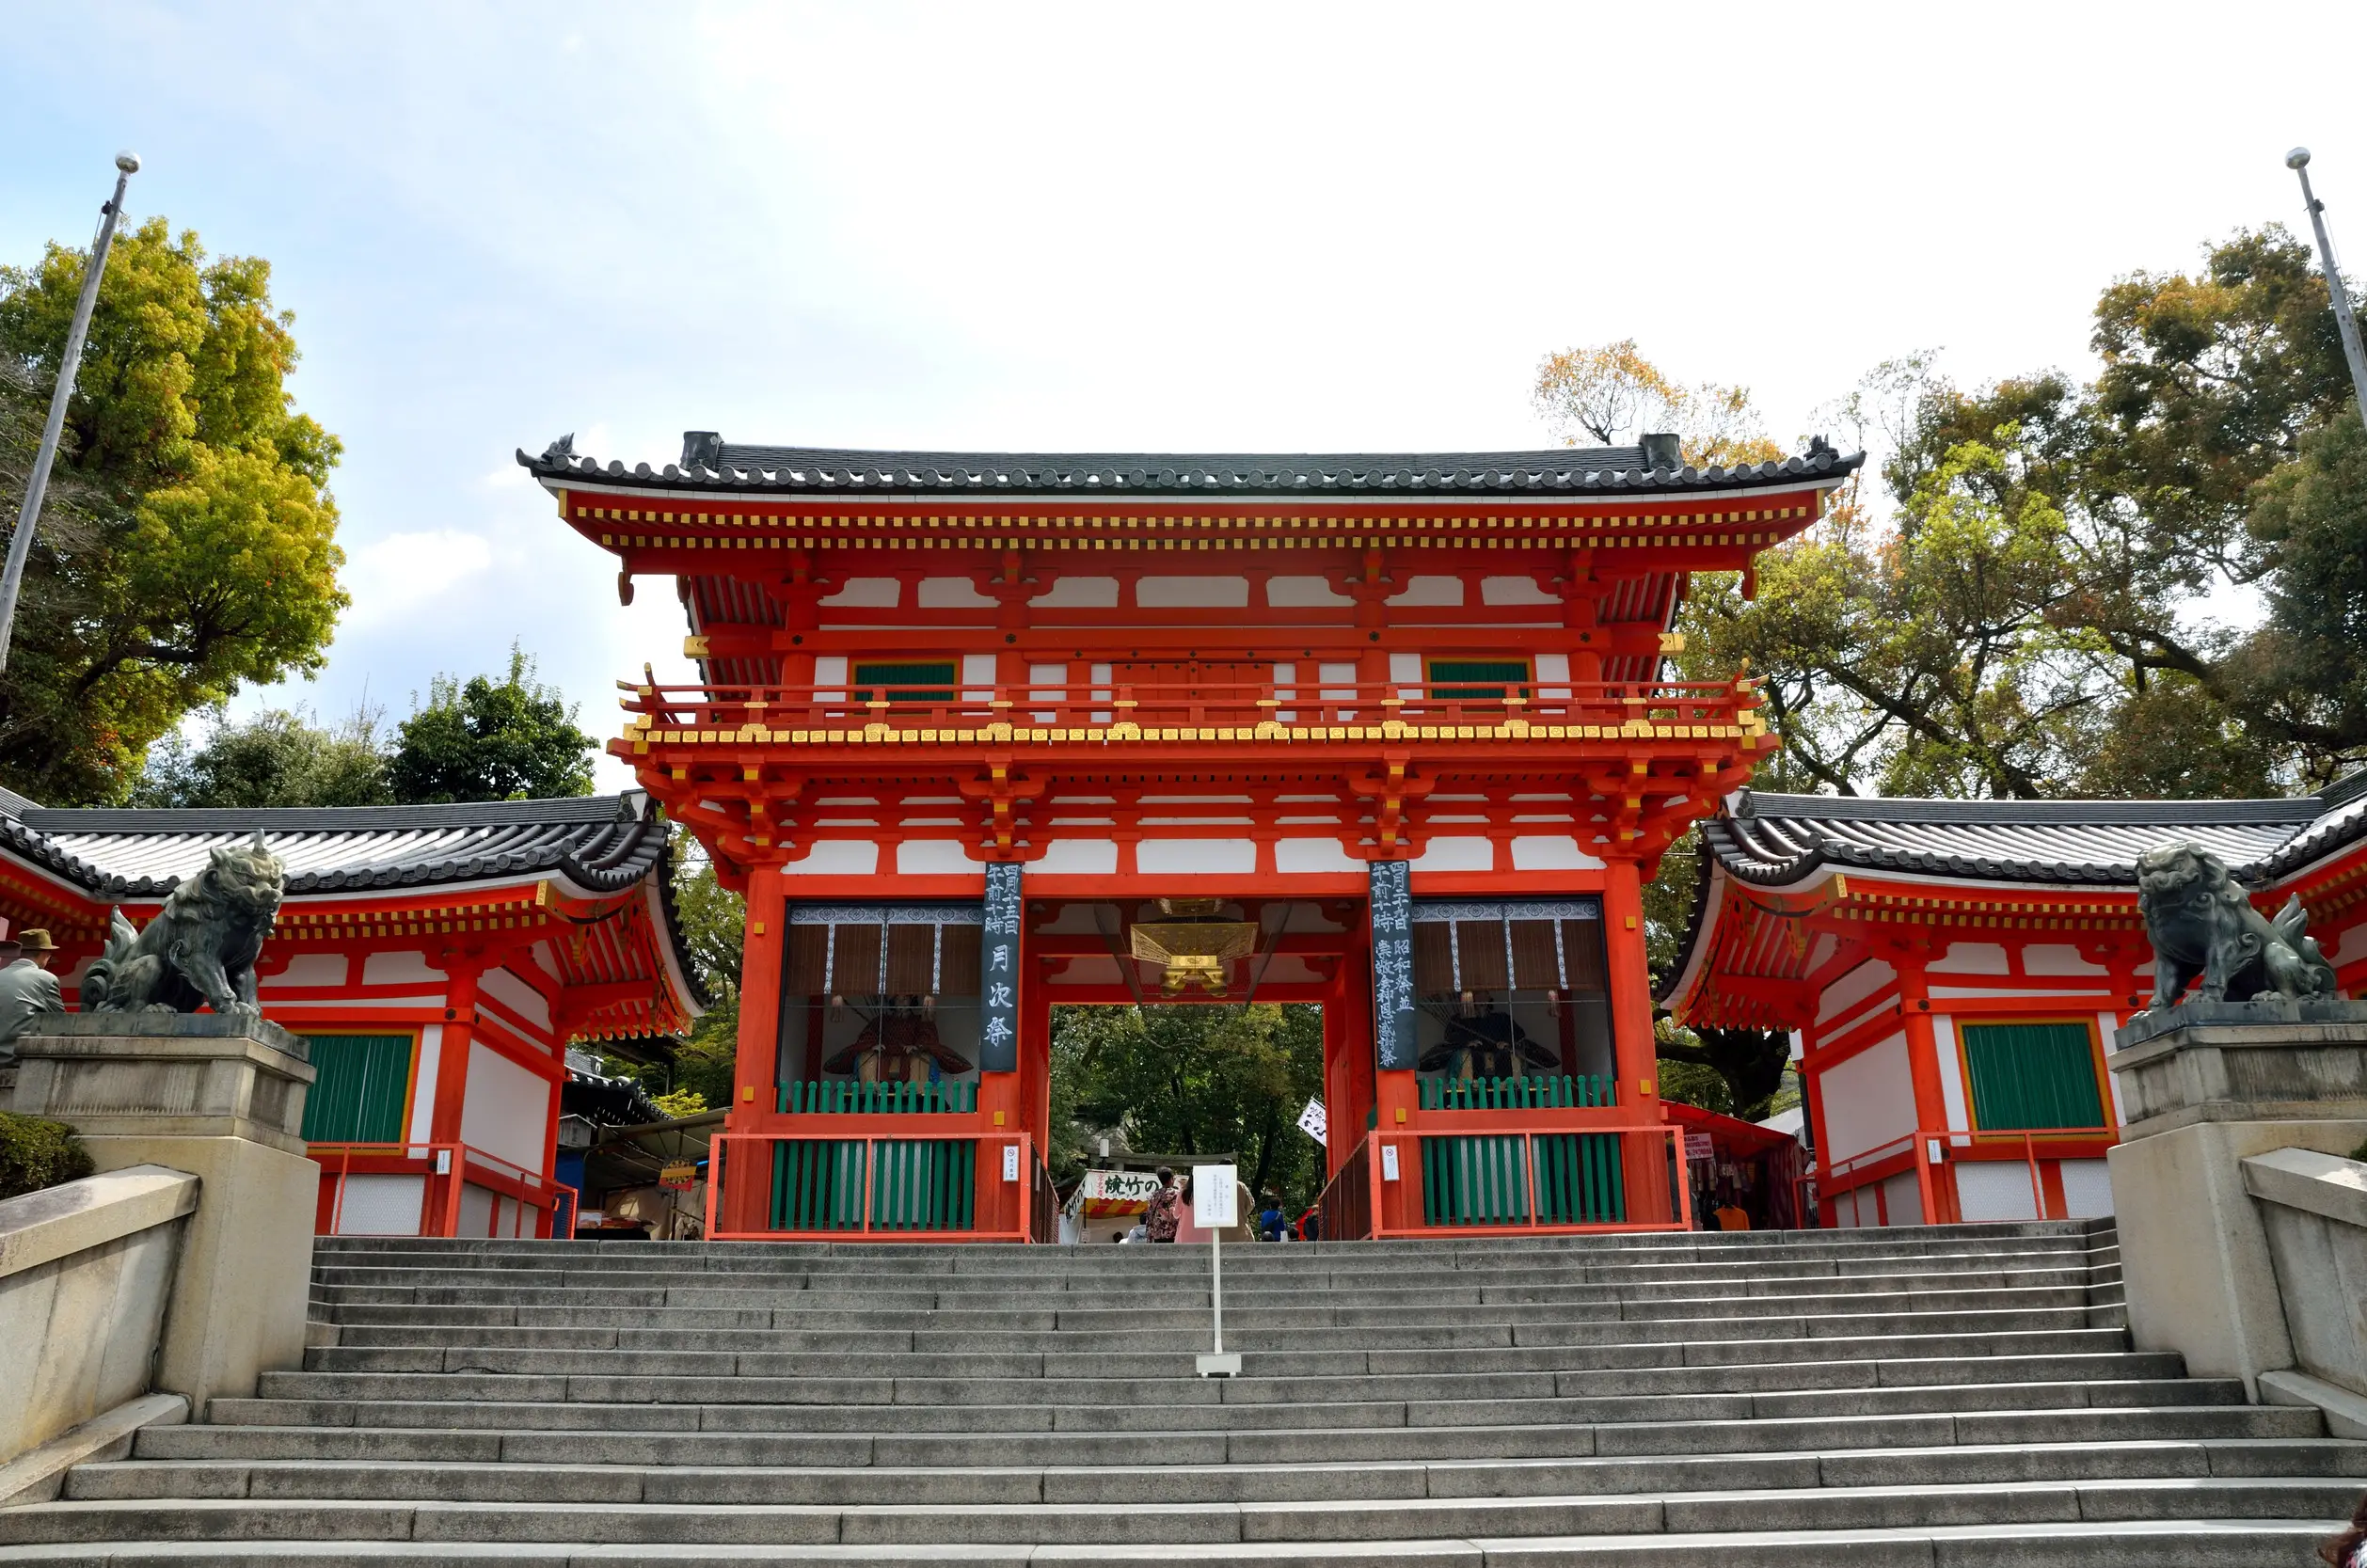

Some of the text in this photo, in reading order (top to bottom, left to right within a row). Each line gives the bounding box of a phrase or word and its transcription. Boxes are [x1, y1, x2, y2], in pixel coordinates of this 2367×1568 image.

[985, 863, 1004, 936] 午前十時
[1002, 864, 1021, 935] 四月十五日
[1371, 862, 1393, 933] 午前十時
[1389, 862, 1409, 930] 四月二十九日
[983, 944, 1013, 1047] 月次祭
[1392, 939, 1415, 1012] 昭和祭並
[1104, 1174, 1179, 1196] 焼竹の
